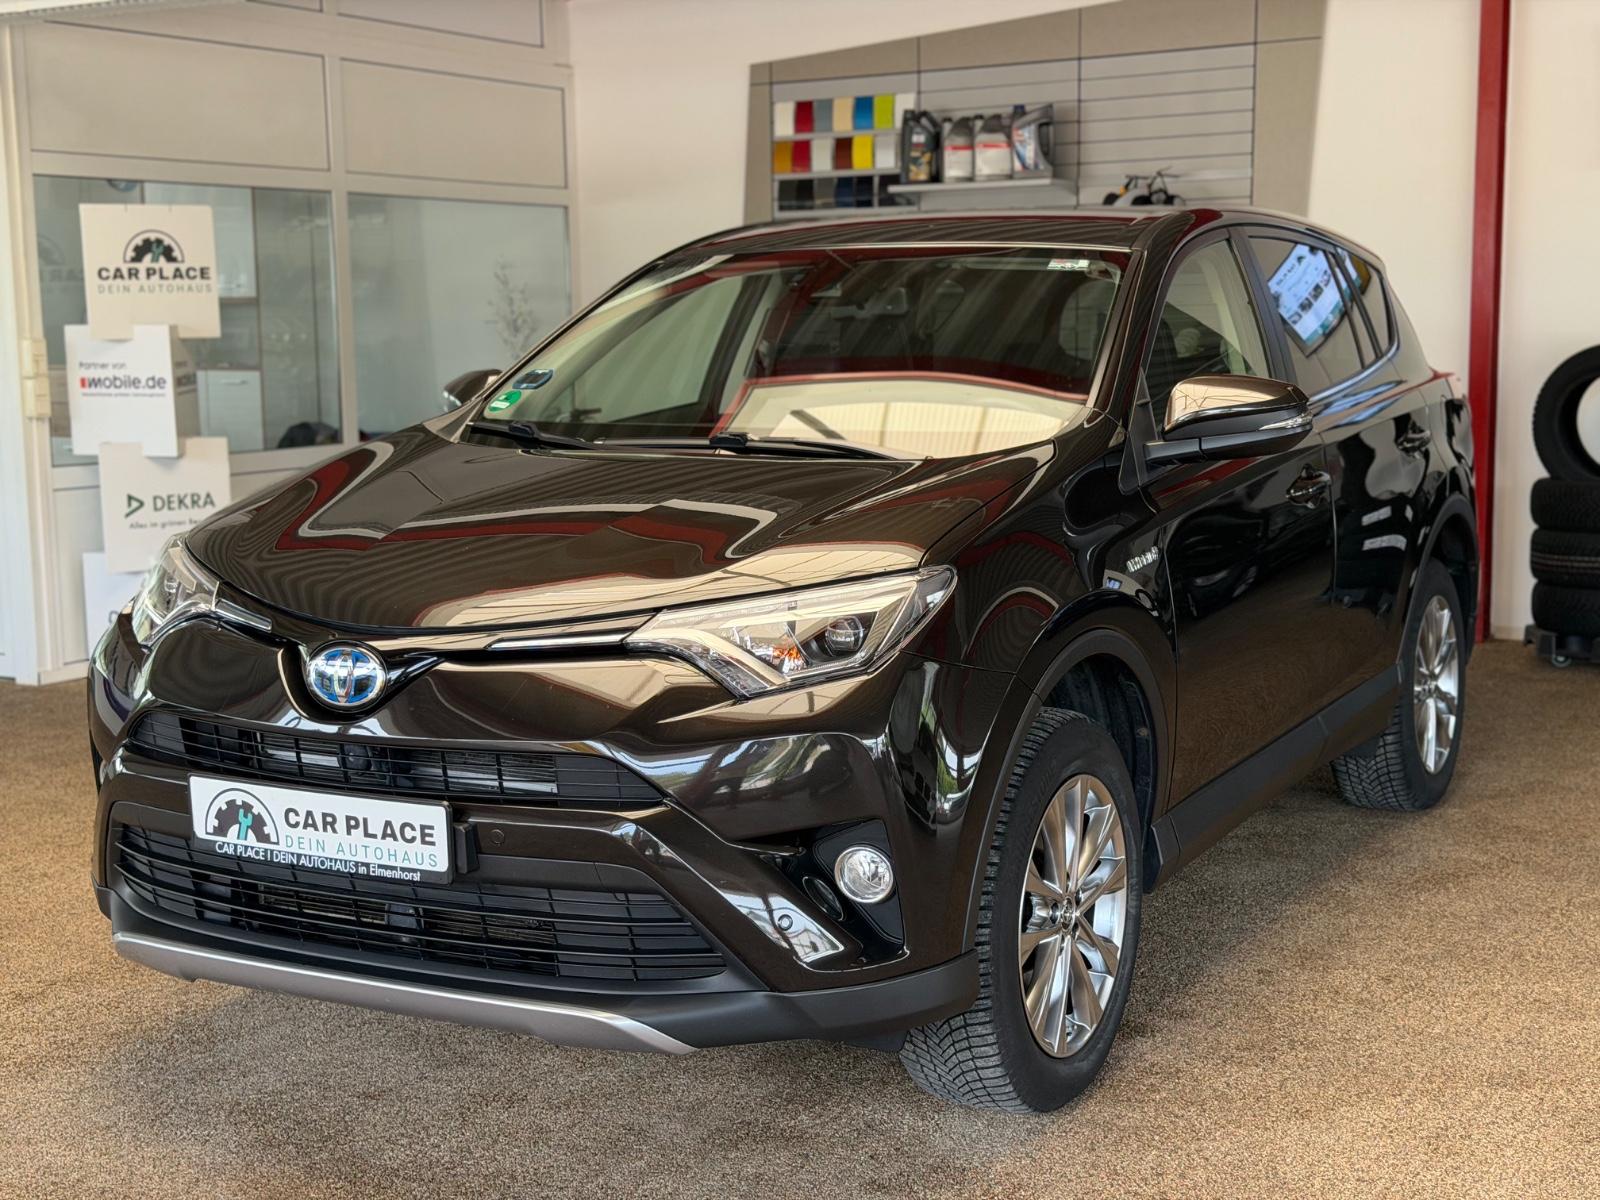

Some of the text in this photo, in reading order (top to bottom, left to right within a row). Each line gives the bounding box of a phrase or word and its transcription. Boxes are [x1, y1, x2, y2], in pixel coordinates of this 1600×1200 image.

[97, 267, 140, 281] CAR
[145, 266, 211, 281] PLACE
[97, 283, 212, 294] DEIN AUTOHAUS
[152, 491, 216, 512] DEKRA
[284, 807, 436, 847] CAR PLACE
[215, 841, 235, 855] CAR
[237, 845, 265, 860] PLACE
[273, 850, 297, 865] DEIN
[298, 853, 356, 873] AUTOHAUS
[358, 863, 367, 875] in
[369, 863, 421, 882] Elmenhorst
[285, 834, 438, 868] DEIN AUTOHAUS
